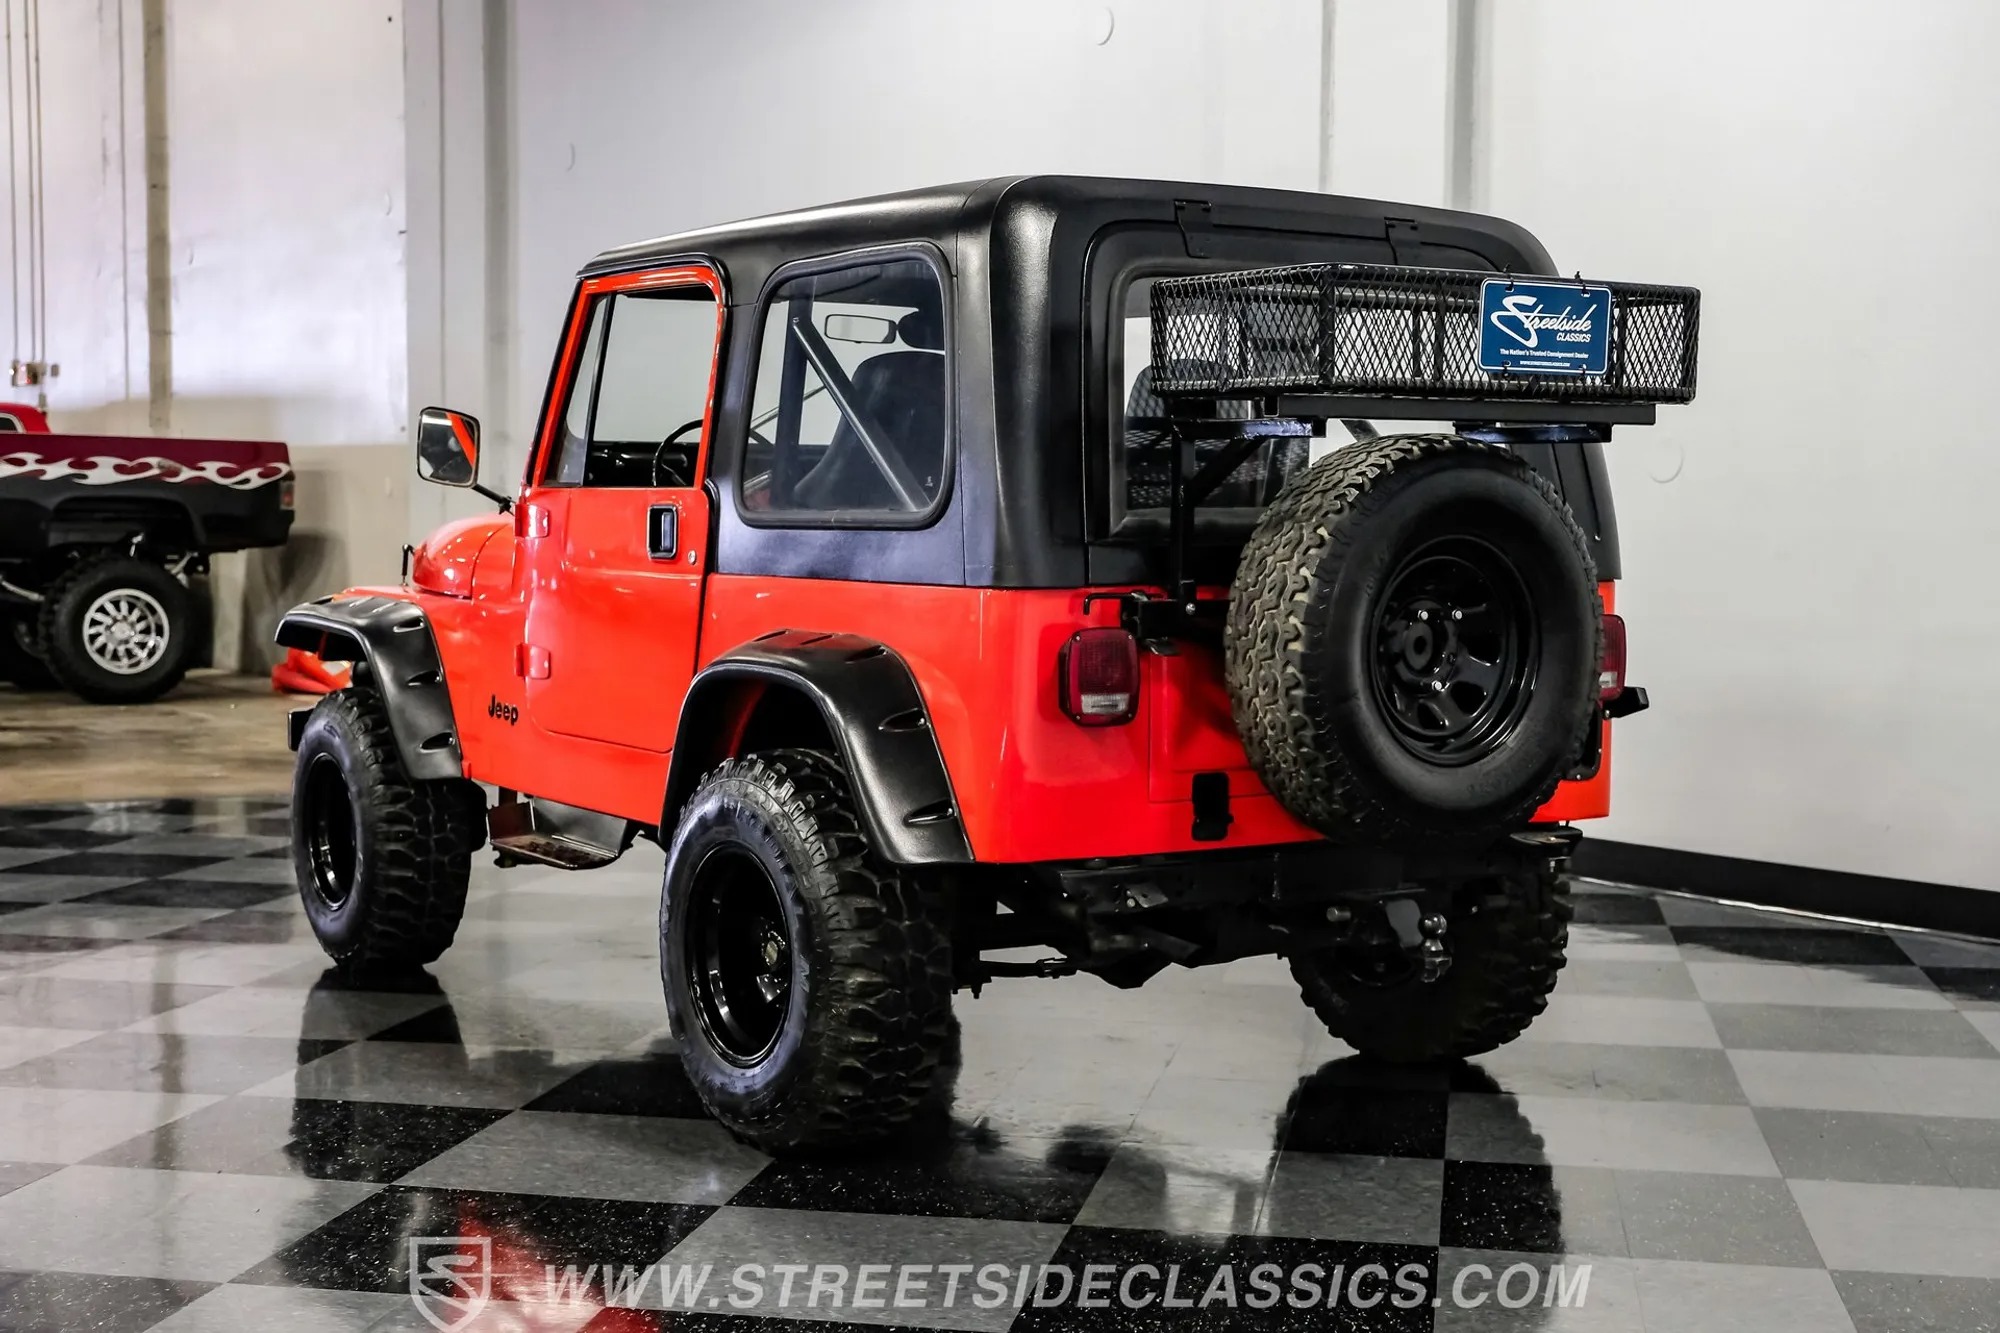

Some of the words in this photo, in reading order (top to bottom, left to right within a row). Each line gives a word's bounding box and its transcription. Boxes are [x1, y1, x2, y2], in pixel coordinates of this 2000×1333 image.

[1490, 295, 1597, 348] Streetside
[1556, 332, 1592, 343] CLASSICS
[488, 694, 519, 726] Jeep
